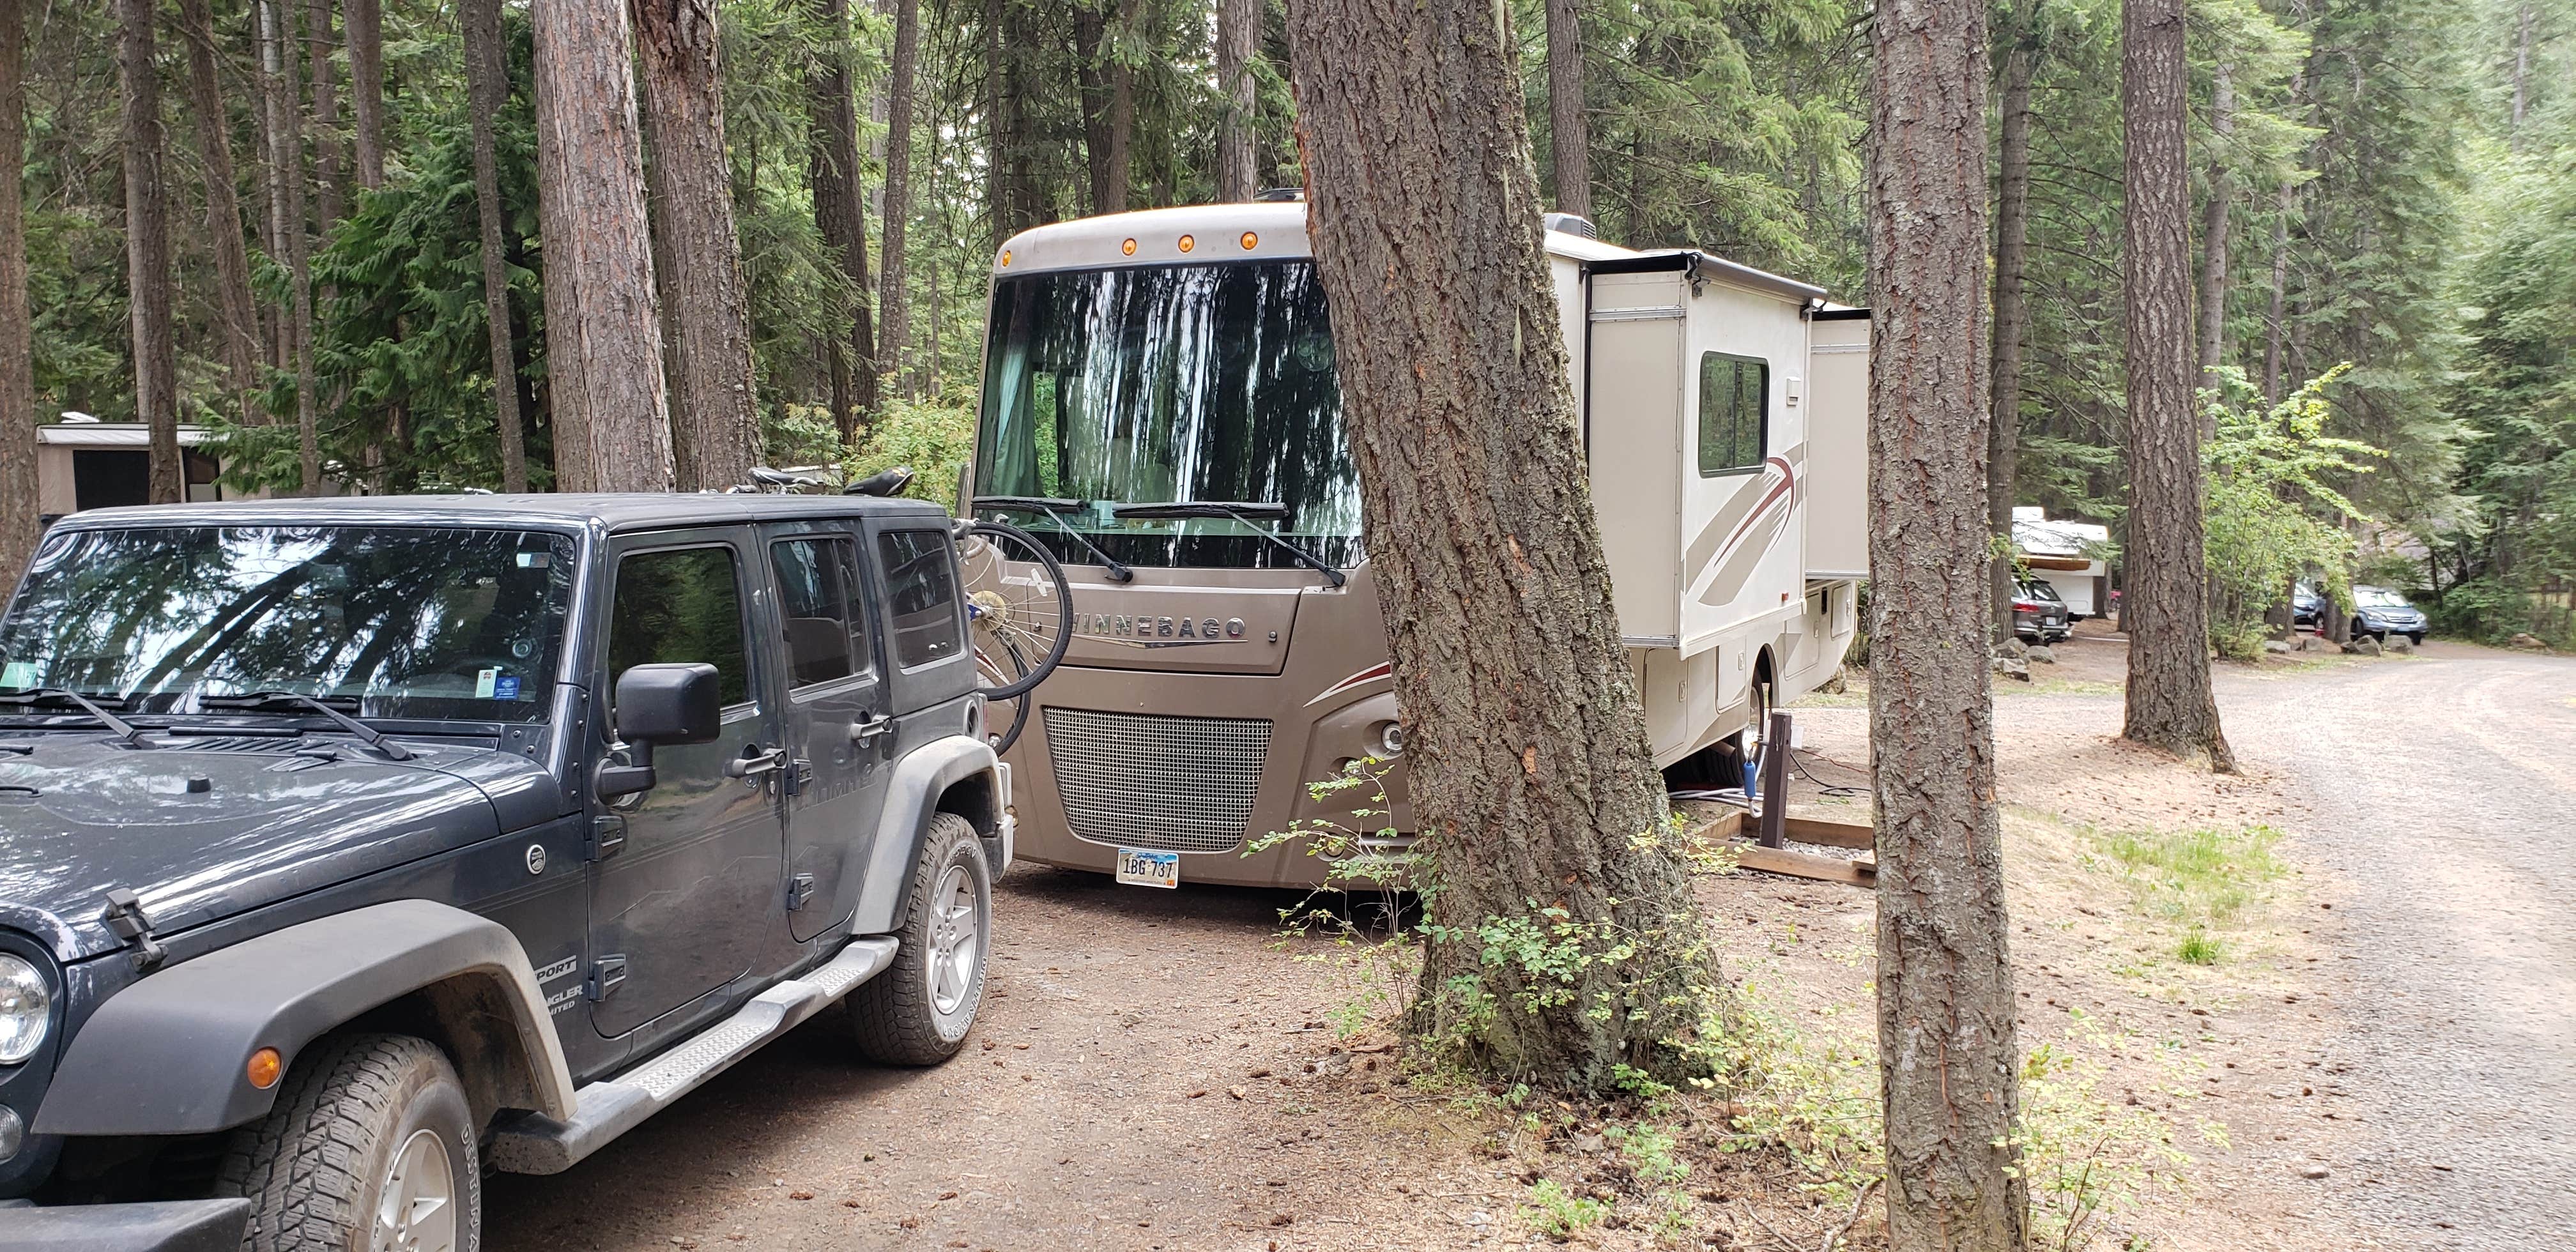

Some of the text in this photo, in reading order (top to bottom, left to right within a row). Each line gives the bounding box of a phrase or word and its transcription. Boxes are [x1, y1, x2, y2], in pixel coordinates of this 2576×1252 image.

[1123, 858, 1173, 878] 1BG 737
[536, 959, 576, 981] PORT
